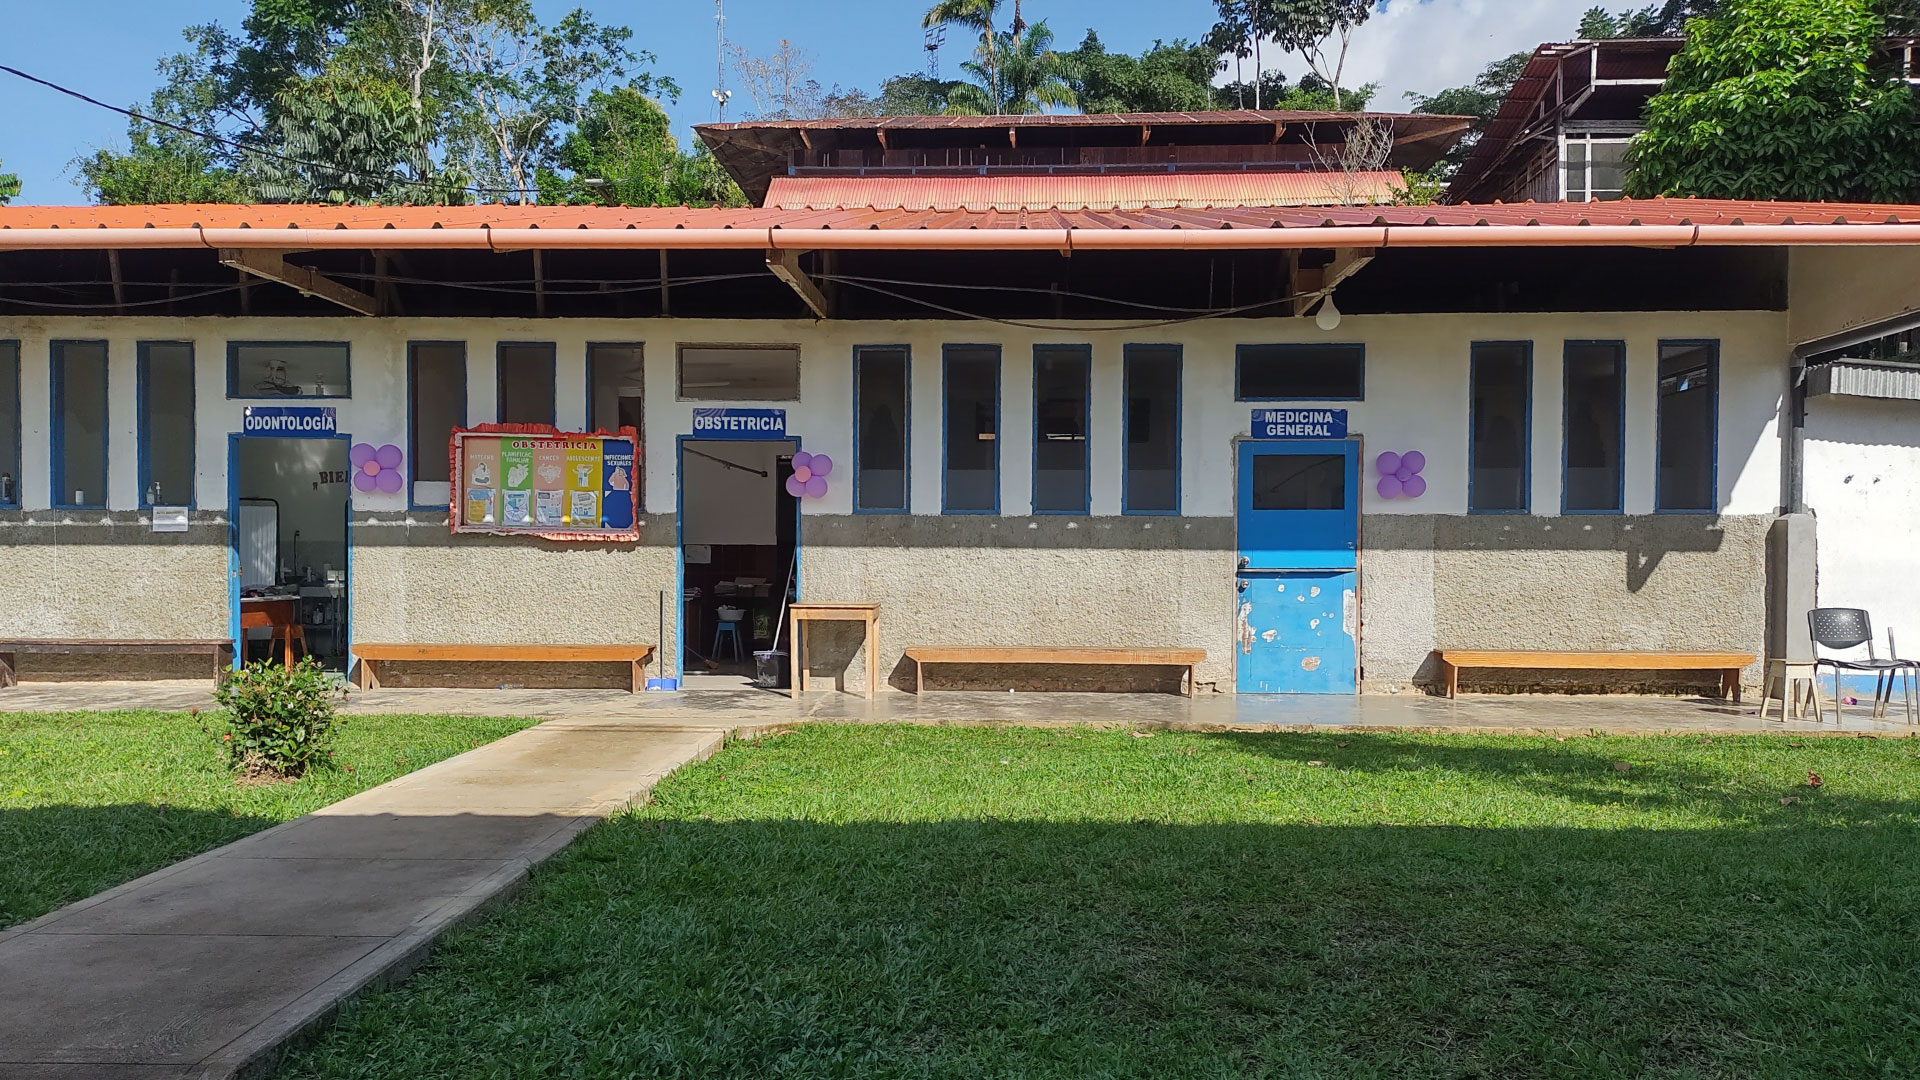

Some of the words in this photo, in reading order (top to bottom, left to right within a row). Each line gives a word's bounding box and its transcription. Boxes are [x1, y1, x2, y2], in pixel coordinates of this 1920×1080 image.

[245, 413, 335, 431] ODONTOLOGÍA
[694, 416, 784, 430] OBSTETRICIA
[1265, 412, 1333, 423] MEDICINA
[1266, 424, 1332, 436] GENERAL
[512, 440, 598, 450] OBSTETRICIA
